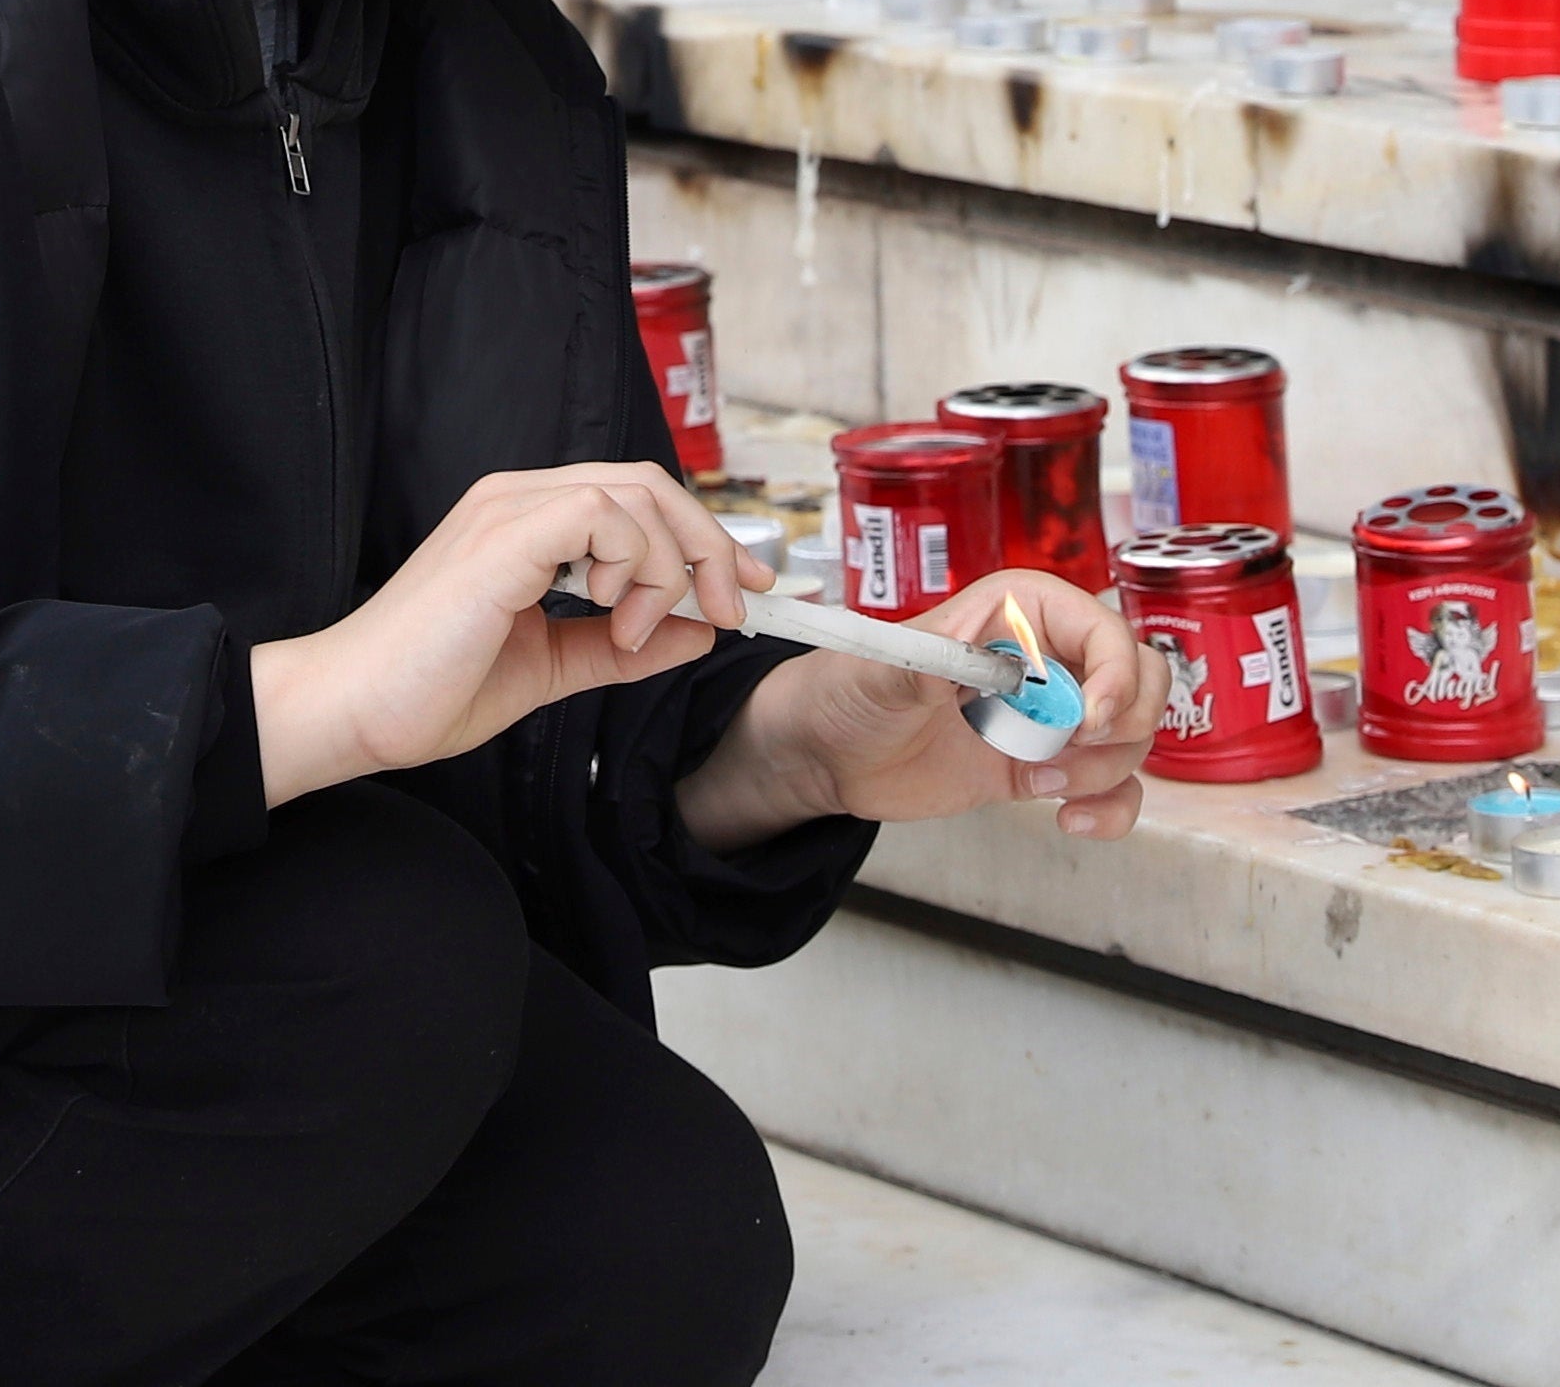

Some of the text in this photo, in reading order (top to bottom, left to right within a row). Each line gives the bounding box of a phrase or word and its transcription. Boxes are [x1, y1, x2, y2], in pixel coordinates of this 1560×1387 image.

[865, 515, 886, 600] Candil
[1269, 617, 1295, 708] Candil
[1404, 659, 1501, 711] Angel
